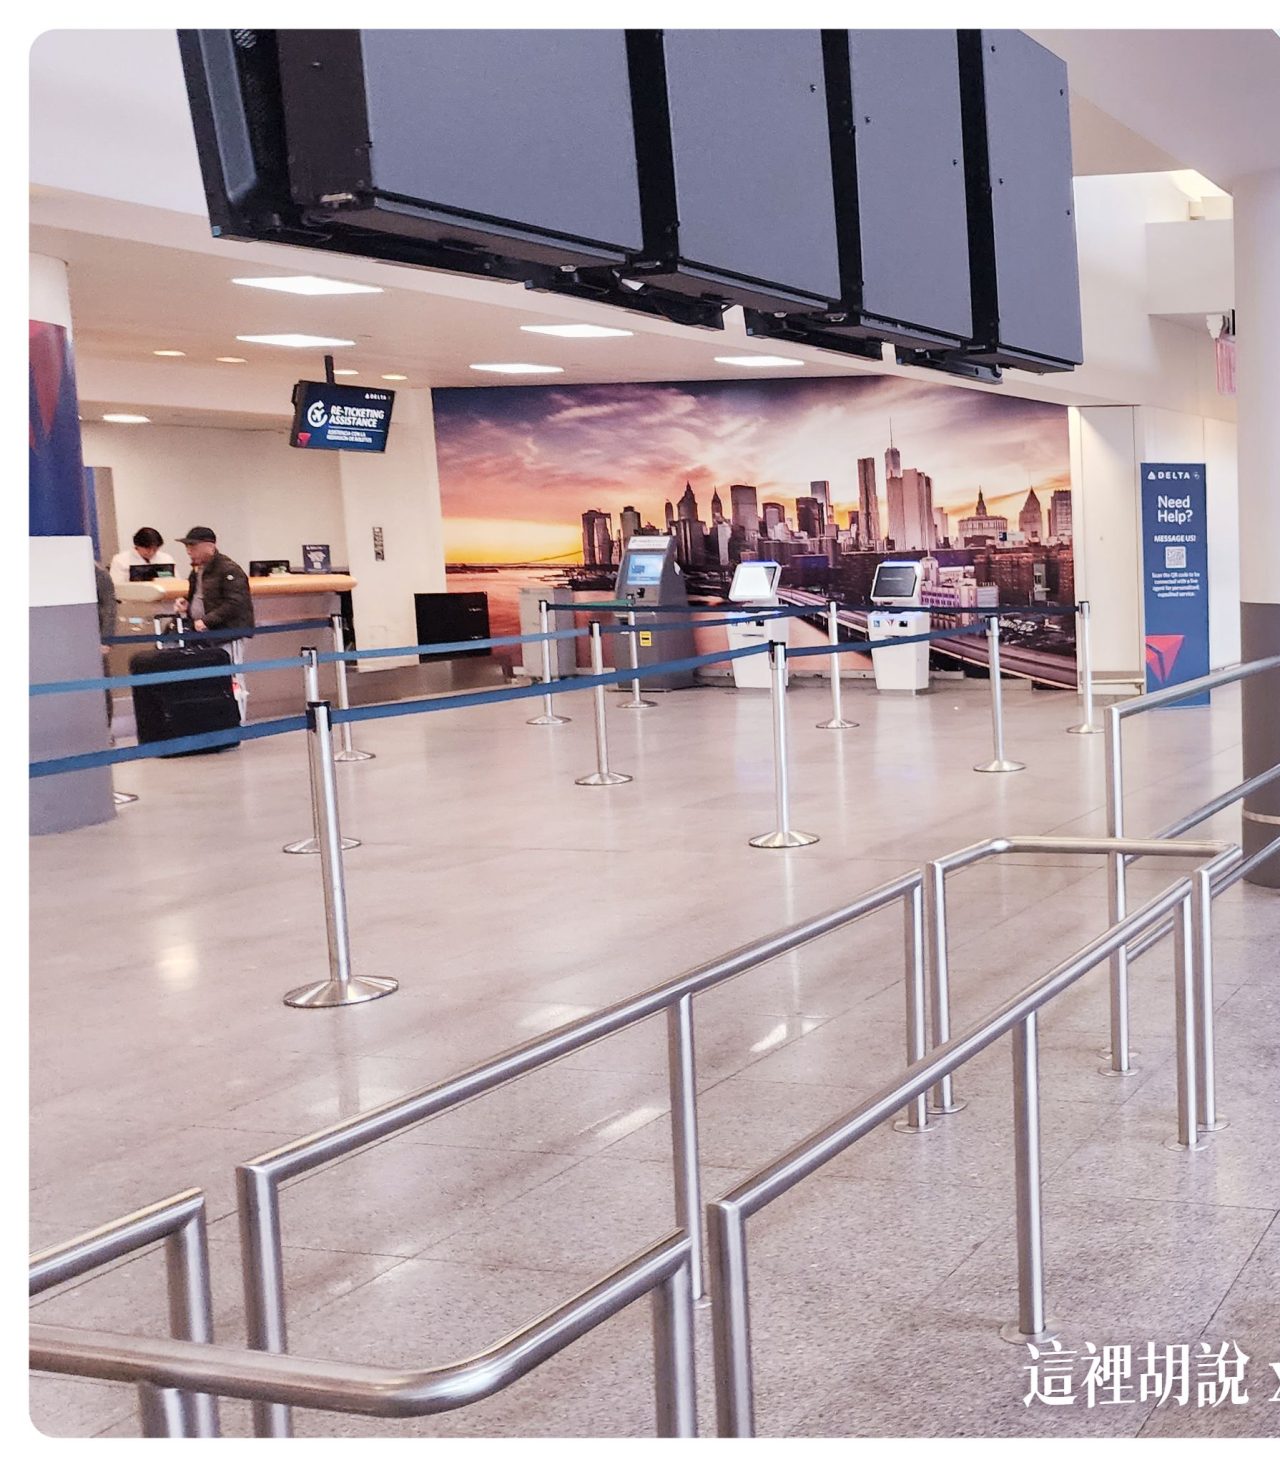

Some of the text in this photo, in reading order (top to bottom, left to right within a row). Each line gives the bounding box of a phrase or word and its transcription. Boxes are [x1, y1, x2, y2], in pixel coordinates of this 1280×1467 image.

[330, 405, 385, 420] RE-TICKETING
[328, 415, 378, 428] ASSISTANCE
[1157, 471, 1191, 480] DELTA
[1157, 495, 1191, 509] Need
[1157, 509, 1194, 525] Help?
[1153, 534, 1185, 543] MESSAGE
